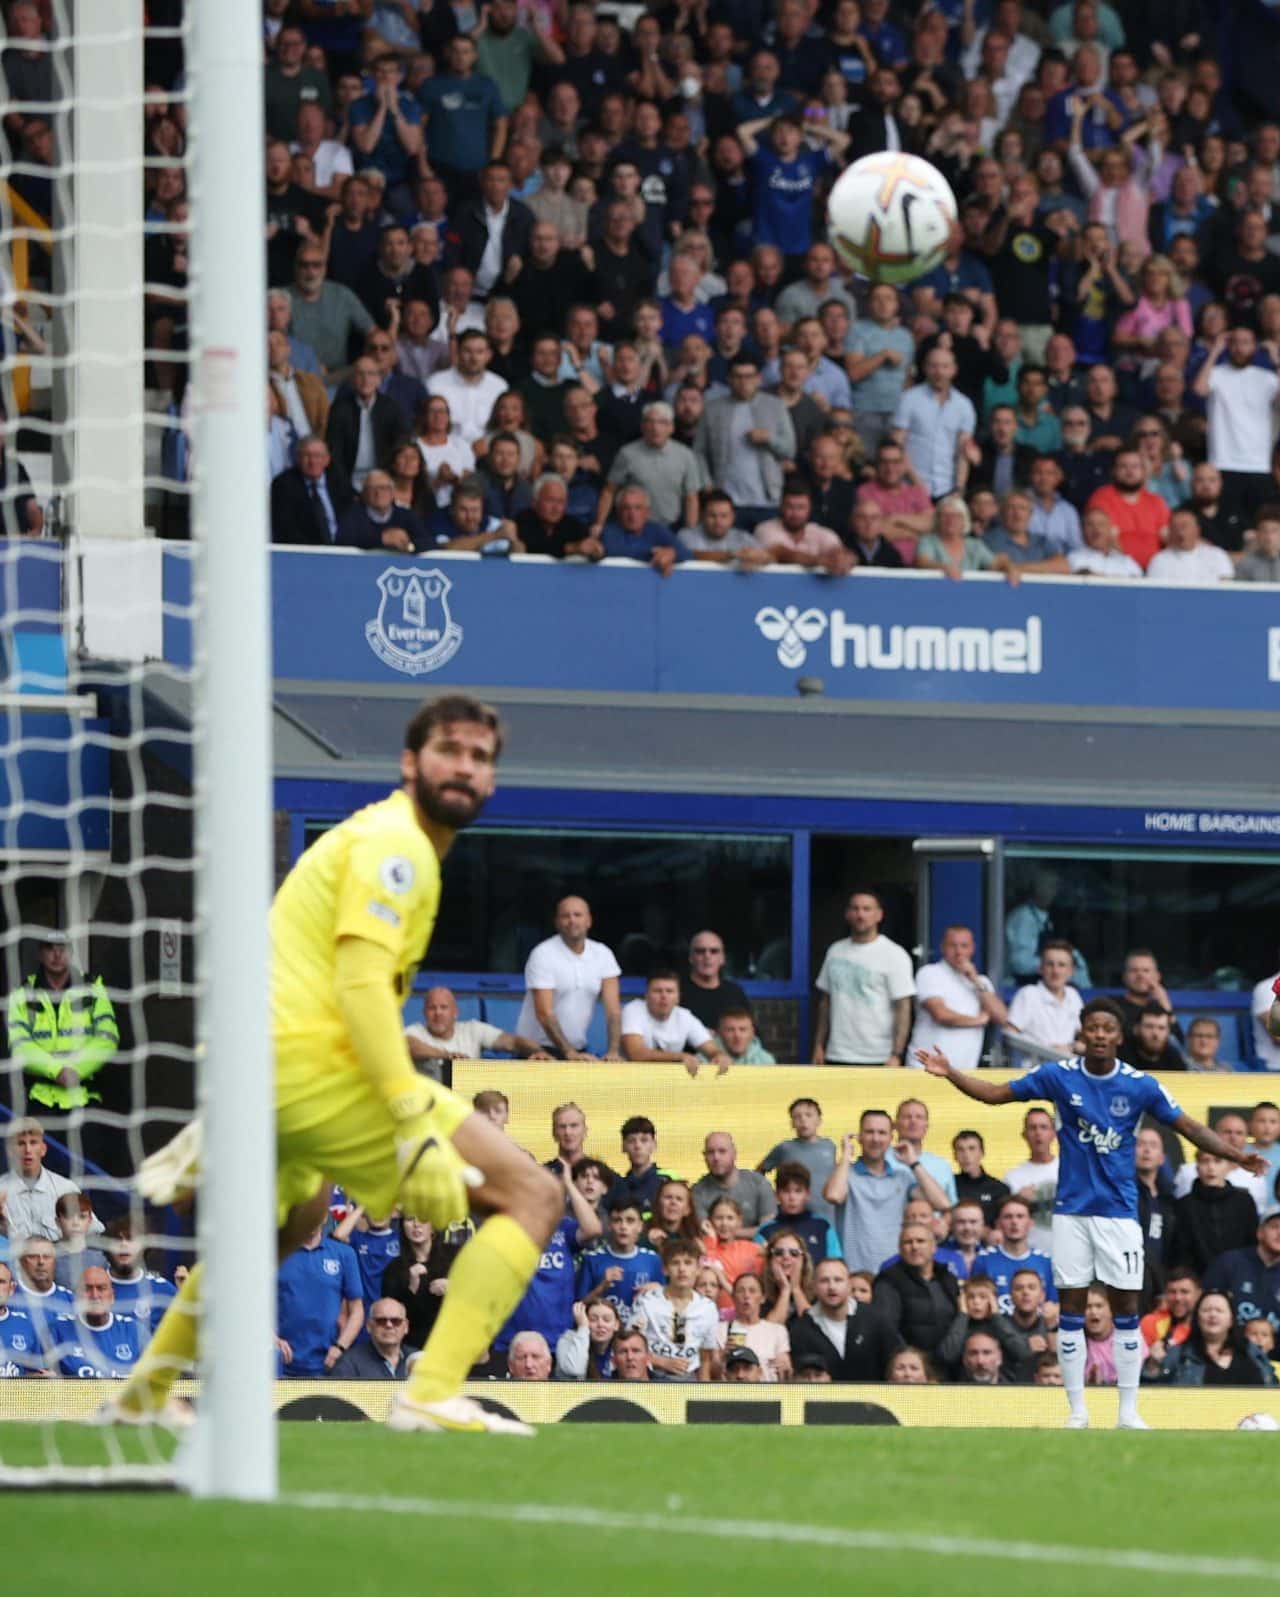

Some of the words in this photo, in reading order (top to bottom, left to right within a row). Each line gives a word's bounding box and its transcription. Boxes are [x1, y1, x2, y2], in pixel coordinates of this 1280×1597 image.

[829, 608, 1042, 675] hummel
[1144, 812, 1197, 832] HOME
[1078, 1117, 1123, 1150] Stake
[537, 1251, 565, 1270] EC
[1122, 1250, 1139, 1275] 11
